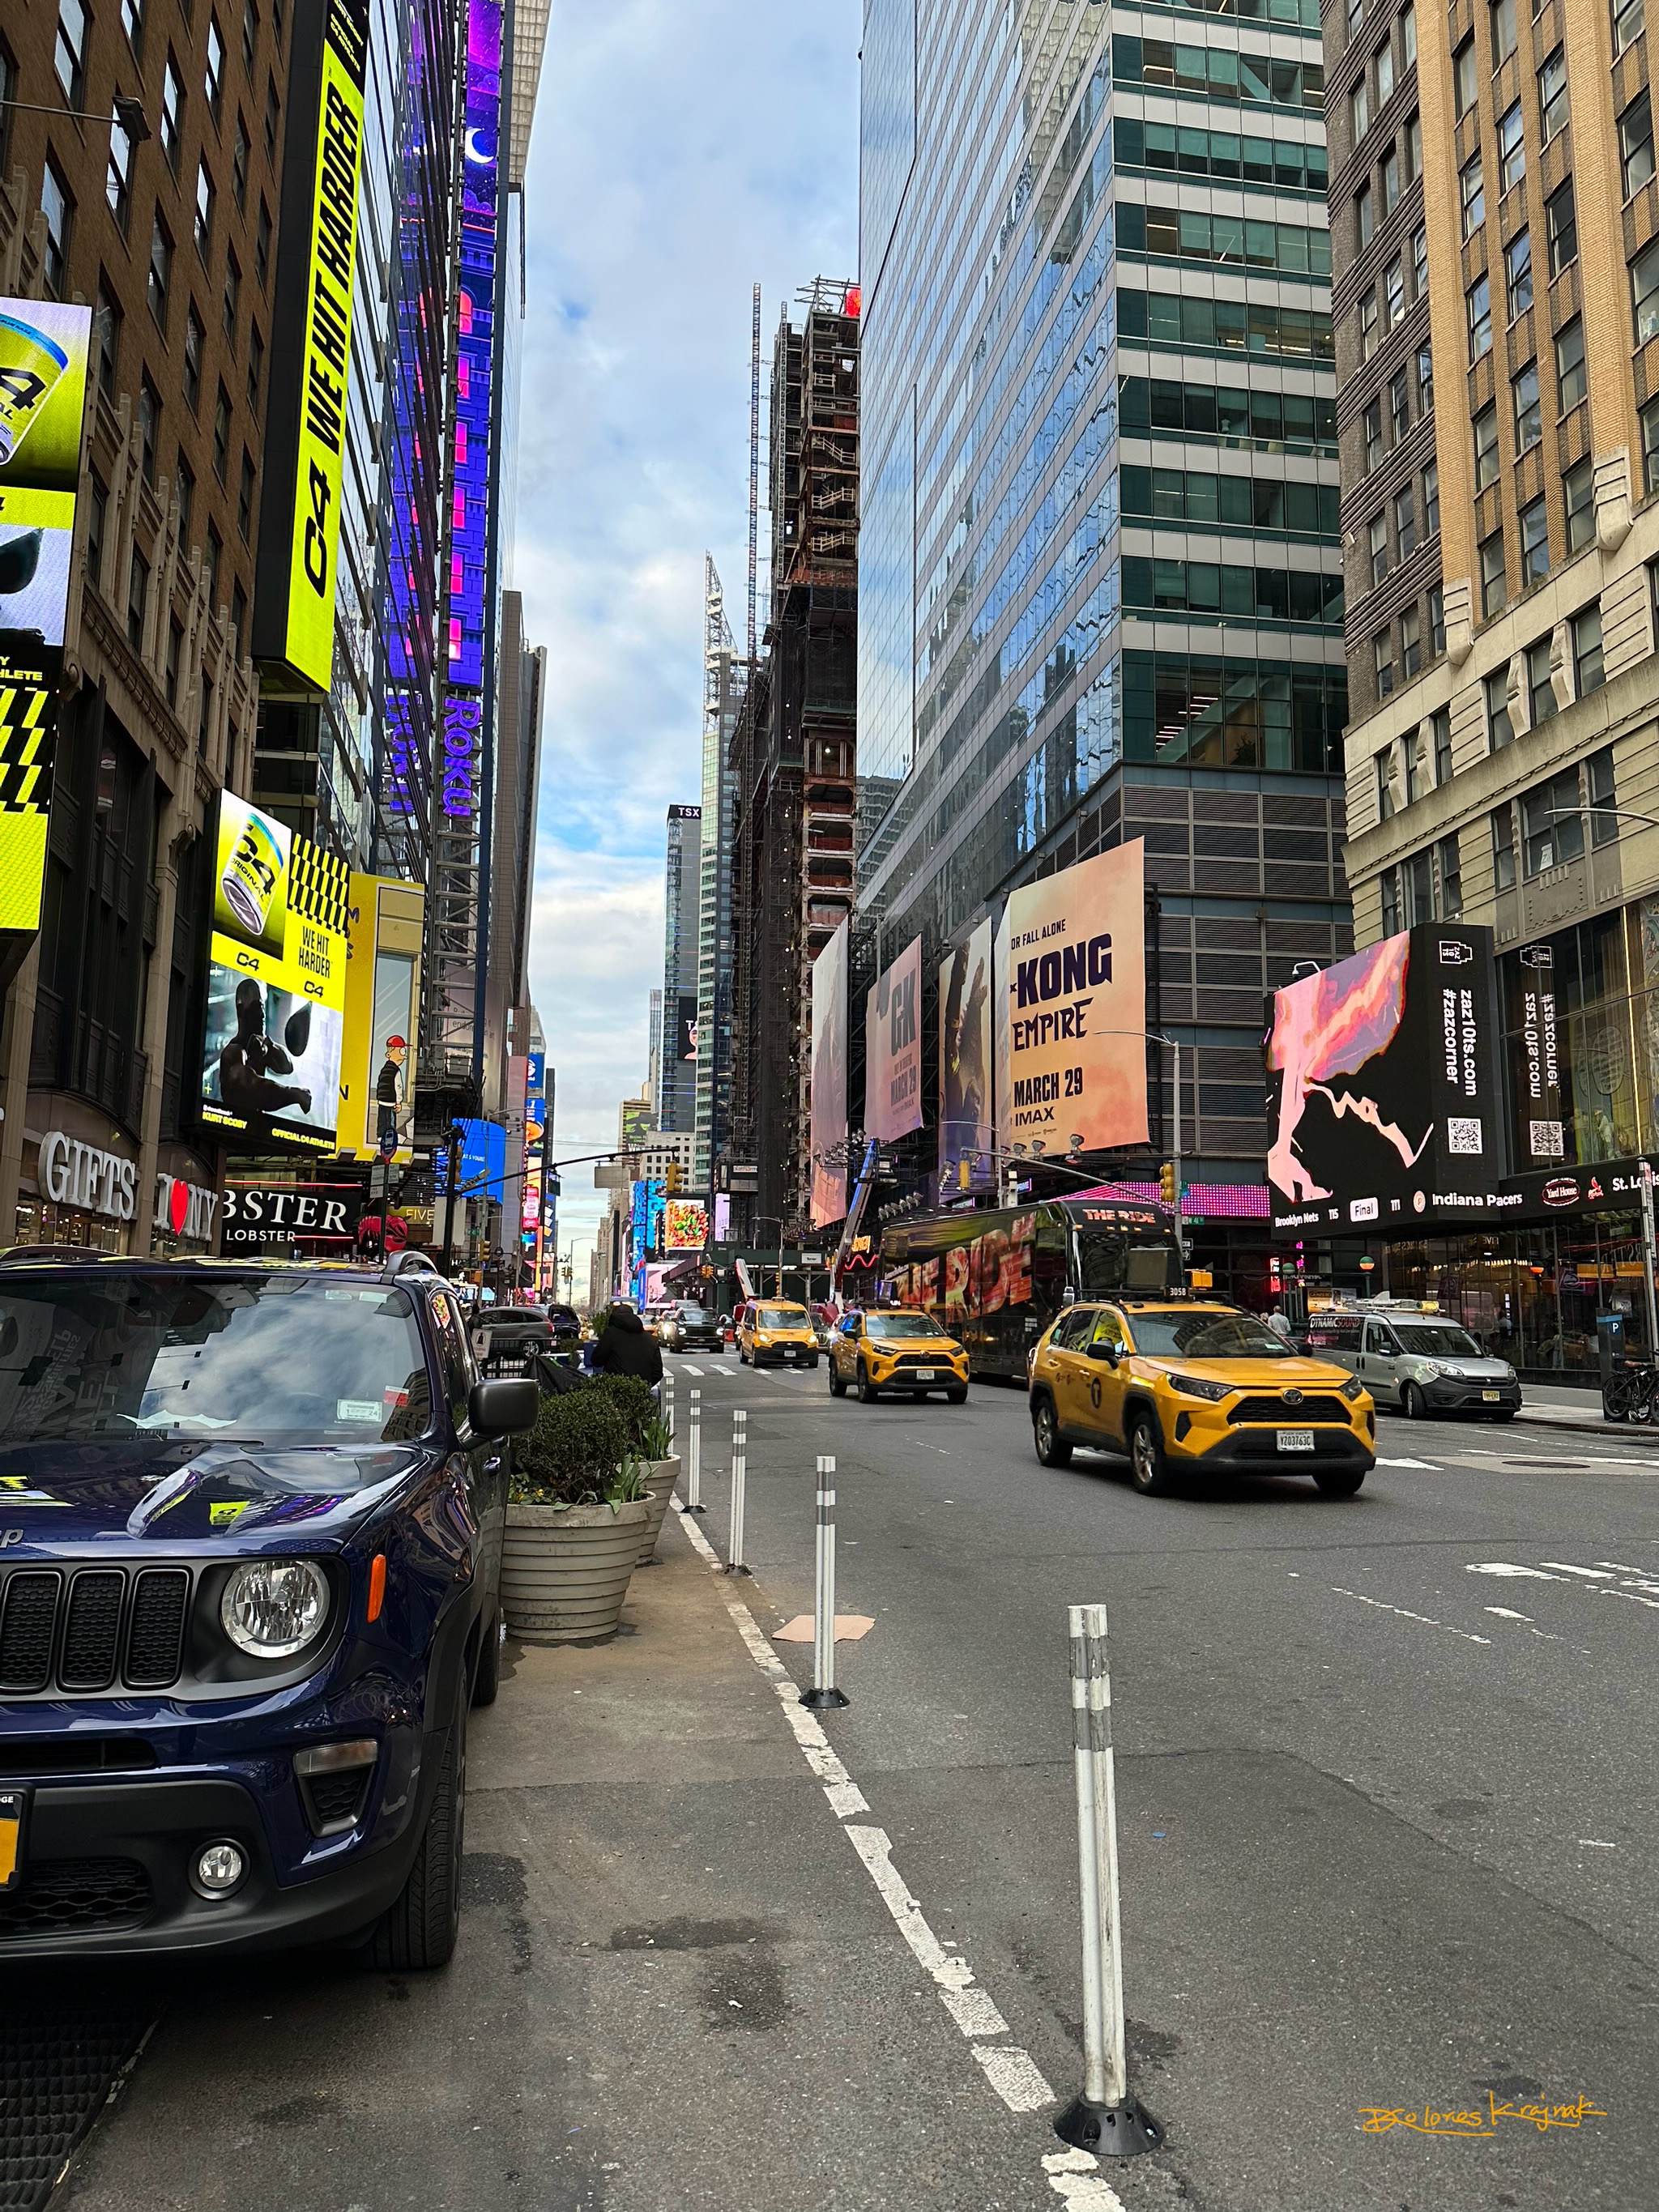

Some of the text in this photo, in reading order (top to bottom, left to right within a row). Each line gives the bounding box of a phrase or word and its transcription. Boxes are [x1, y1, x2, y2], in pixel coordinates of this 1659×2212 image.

[303, 80, 359, 599] C4 WE HIT HARDER
[678, 807, 700, 817] TSX
[302, 925, 315, 951] WE
[315, 932, 330, 957] HIT
[1011, 918, 1067, 951] OR FALL ALONE
[237, 952, 260, 972] C4
[297, 946, 331, 978] HARDER
[1017, 933, 1113, 1010] KONG
[304, 980, 324, 998] C4
[1012, 996, 1094, 1052] EMPIRE
[1443, 988, 1459, 1085] #zazcorner
[1461, 989, 1477, 1096] zaz10ts.com
[1014, 1067, 1084, 1108] MARCH 29
[1015, 1106, 1056, 1127] IMAX
[271, 1127, 301, 1142] OFFICIAL
[39, 1131, 136, 1221] GIFTS
[1612, 1177, 1629, 1191] St.
[1546, 1186, 1578, 1199] Yard House
[186, 1183, 220, 1242] NY
[406, 1208, 436, 1221] FIVE
[1082, 1208, 1156, 1224] THE RIDE
[1274, 1214, 1303, 1227] Brooklyn
[1303, 1212, 1320, 1224] Nets
[1328, 1208, 1339, 1221] 115
[1354, 1203, 1374, 1217] Final
[1390, 1199, 1401, 1212] 111
[1432, 1193, 1483, 1207] Indiana
[1487, 1193, 1523, 1207] Pacers
[226, 1229, 296, 1242] LOBSTER
[1170, 1287, 1187, 1296] 3058
[1612, 1323, 1619, 1333] P
[0, 1528, 24, 1549] p
